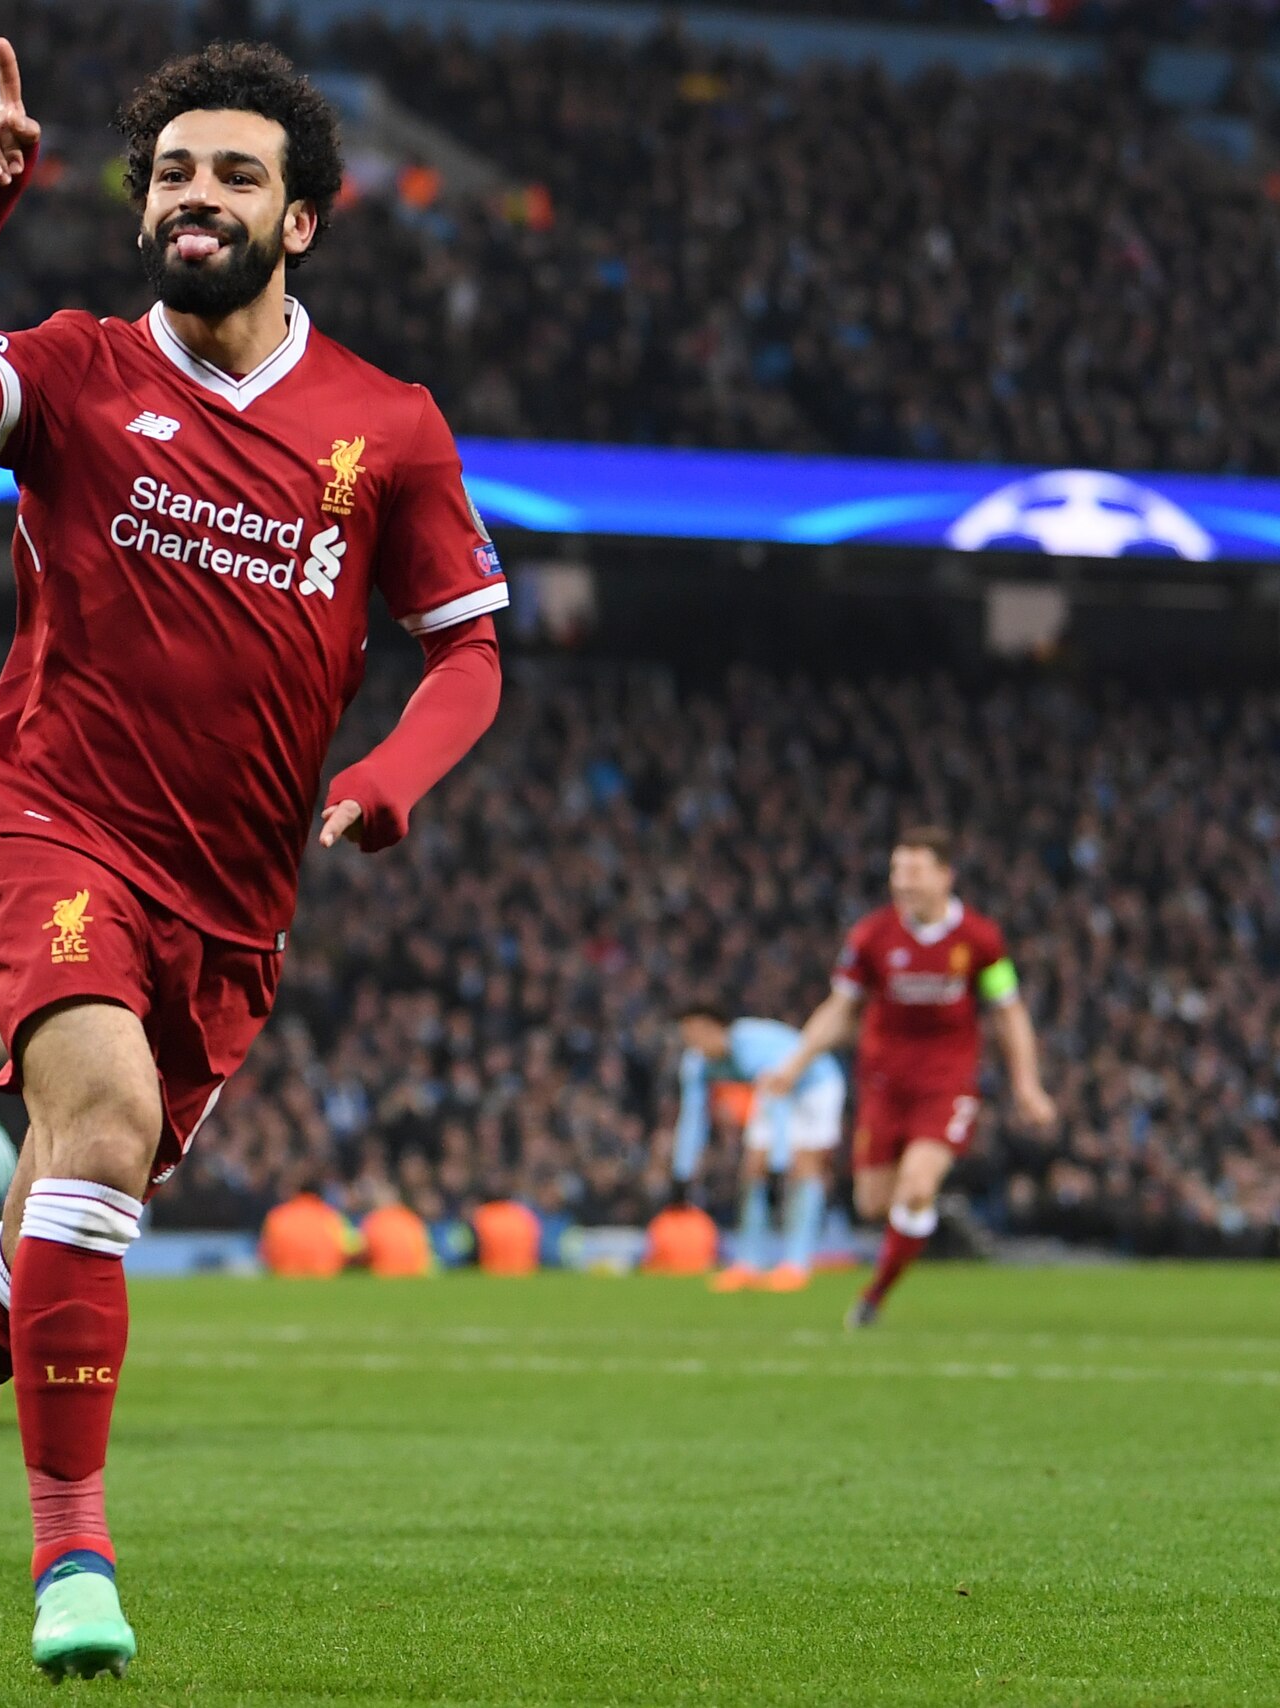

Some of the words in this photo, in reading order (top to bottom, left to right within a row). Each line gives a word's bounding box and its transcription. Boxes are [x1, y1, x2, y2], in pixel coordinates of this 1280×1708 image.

[130, 476, 304, 550] Standard
[323, 487, 355, 507] LFC
[110, 513, 296, 590] Chartered
[51, 939, 90, 955] LFC
